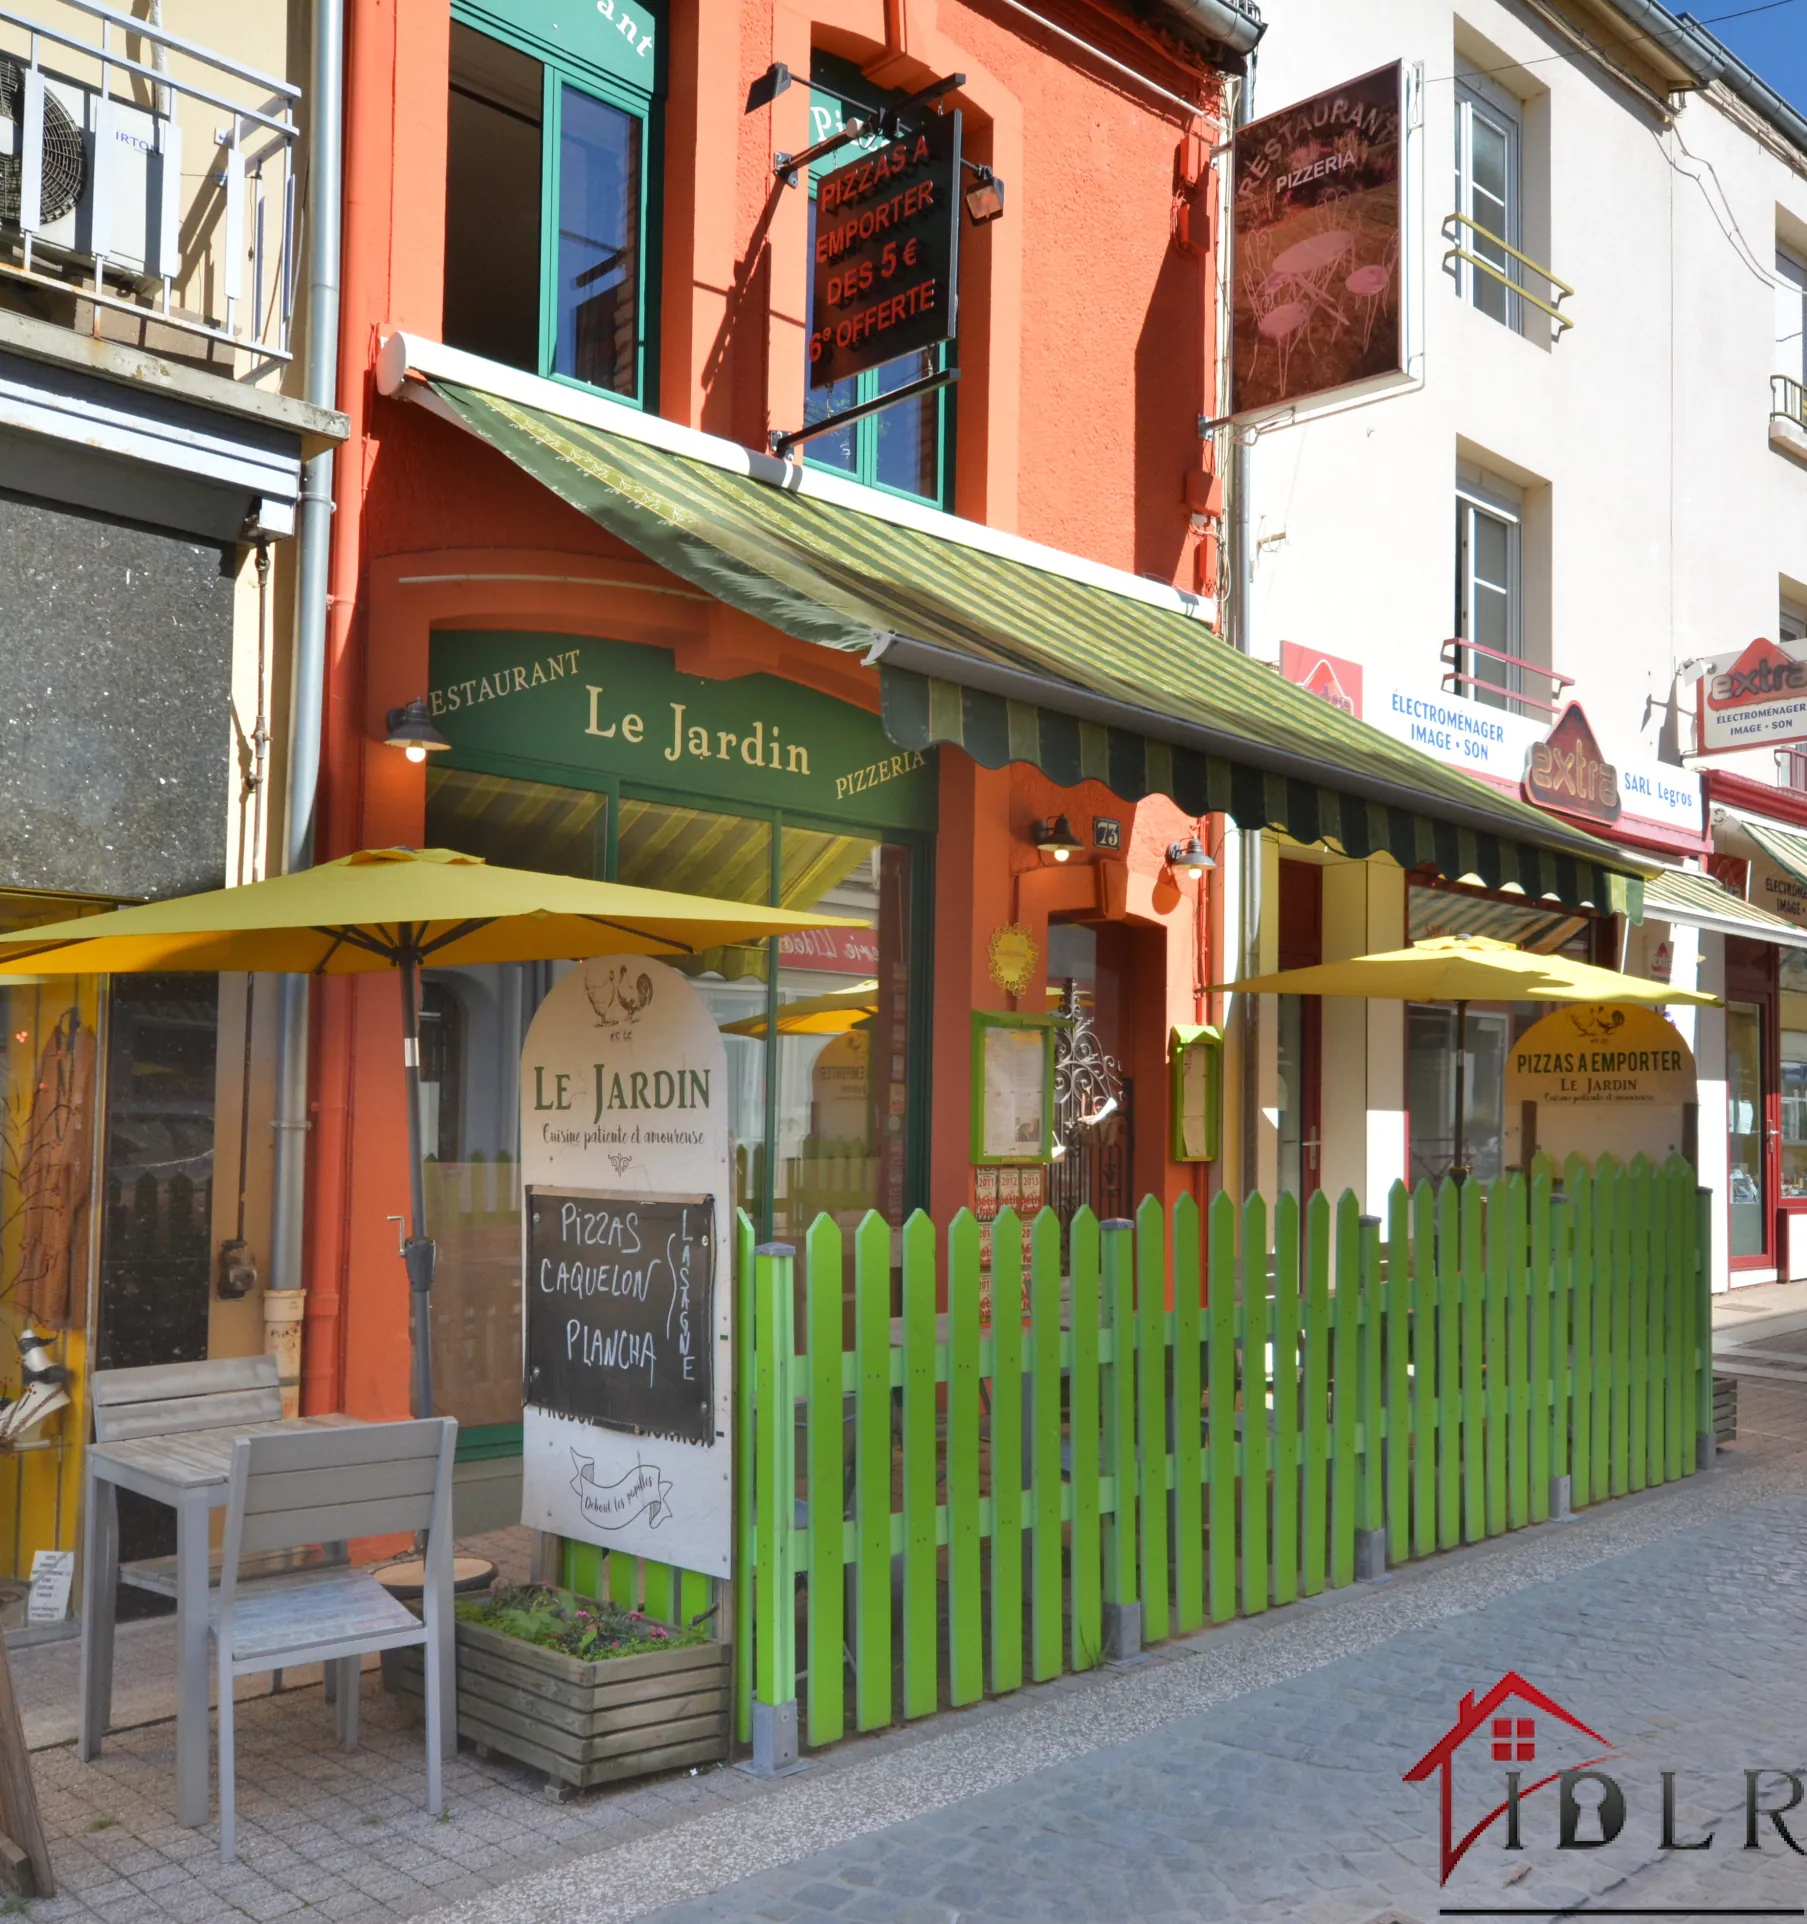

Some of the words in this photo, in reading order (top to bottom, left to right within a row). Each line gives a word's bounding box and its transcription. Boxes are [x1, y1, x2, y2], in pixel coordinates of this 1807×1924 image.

[1238, 98, 1396, 199] RESTAURANT
[822, 144, 907, 212] PIZZAS
[903, 135, 930, 163] A
[1276, 149, 1356, 193] PIZZERIA
[816, 180, 933, 263] EMPORTER
[827, 261, 873, 305] DES
[881, 241, 897, 278] 5
[836, 278, 935, 348] OFFERTE
[1711, 658, 1807, 701] extra
[585, 684, 644, 743] Le
[663, 703, 811, 775] Jardin
[1392, 688, 1504, 743] ÉLECTROMÉNAGER
[1716, 702, 1807, 724] ÉLECTROMÉNAGER
[1730, 724, 1762, 736] IMAGE
[1772, 719, 1793, 730] SON
[1411, 723, 1452, 751] IMAGE
[1464, 739, 1489, 761] SON
[835, 749, 926, 800] PIZZERIA
[1531, 739, 1618, 808] extra
[1624, 772, 1652, 796] SARL
[1657, 782, 1693, 808] Legros
[1097, 821, 1118, 846] 73
[1776, 897, 1801, 916] IMAGE
[1517, 1053, 1574, 1074] PIZZAS
[1577, 1054, 1588, 1073] A
[1591, 1051, 1682, 1073] EMPORTER
[534, 1066, 572, 1111] LE
[593, 1063, 711, 1125] JARDIN
[1560, 1078, 1578, 1092] LE
[1588, 1077, 1637, 1094] JARDIN
[543, 1122, 580, 1144] Cuisine
[584, 1124, 628, 1150] patiente
[630, 1123, 641, 1144] et
[643, 1128, 704, 1145] amoureuse
[1001, 1176, 1018, 1187] 2012
[1023, 1175, 1039, 1187] 2013
[540, 1258, 663, 1302] CAQUELON
[566, 1318, 657, 1389] PLANCHA
[584, 1495, 612, 1514] Debout
[614, 1496, 625, 1512] les
